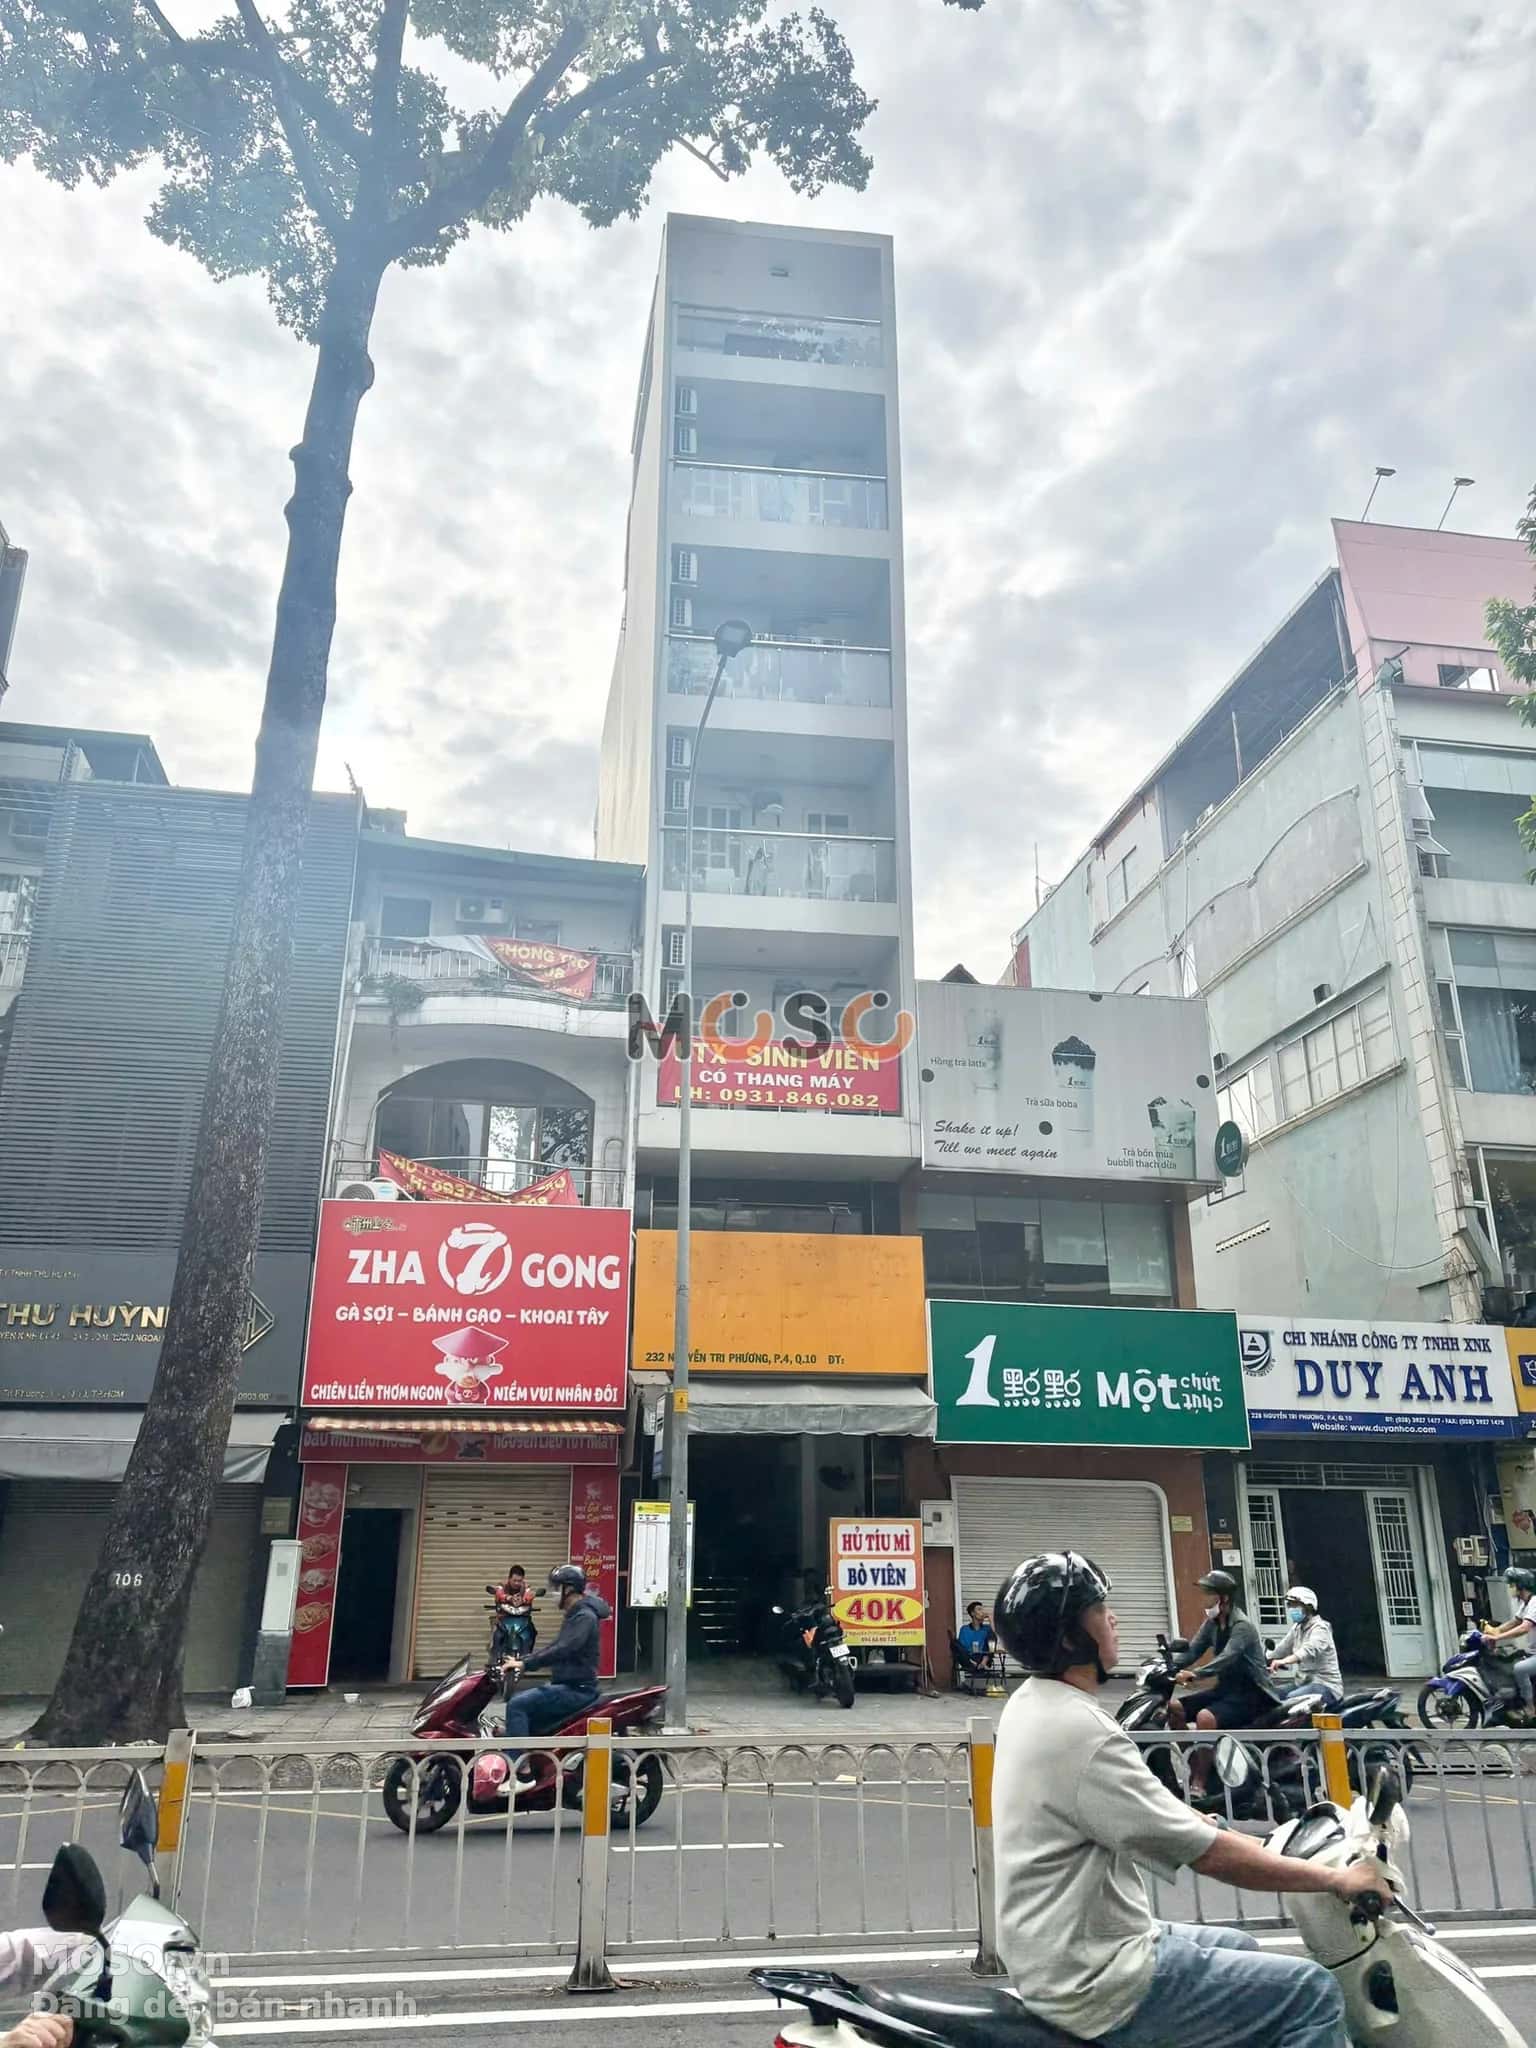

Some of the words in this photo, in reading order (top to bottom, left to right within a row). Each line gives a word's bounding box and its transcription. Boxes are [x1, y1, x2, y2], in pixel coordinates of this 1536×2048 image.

[745, 1045, 808, 1069] SINH
[818, 1045, 881, 1072] VIÊN
[699, 1068, 728, 1084] CÓ
[734, 1071, 804, 1088] THANG
[810, 1073, 855, 1089] MÁY
[719, 1087, 880, 1108] 0931.846.082
[1056, 1098, 1078, 1109] boba
[934, 1119, 976, 1135] Shake
[980, 1124, 992, 1136] it
[995, 1123, 1019, 1139] up!
[934, 1139, 960, 1153] Till
[964, 1144, 982, 1155] we
[986, 1146, 1017, 1157] meet
[1020, 1148, 1058, 1161] again
[347, 1248, 427, 1286] ZHA
[520, 1253, 621, 1290] GONG
[69, 1299, 170, 1329] HUỲN
[335, 1302, 360, 1322] GÀ
[362, 1303, 394, 1325] SỢI
[412, 1303, 463, 1324] BÁNH
[465, 1310, 502, 1326] GẠO
[520, 1308, 573, 1326] KHOAI
[577, 1306, 610, 1326] TÂY
[1283, 1331, 1308, 1346] CHI
[1310, 1328, 1358, 1349] NHÁNH
[1361, 1330, 1398, 1350] CÔNG
[1401, 1335, 1418, 1350] TY
[1422, 1335, 1461, 1352] TNHH
[1463, 1337, 1493, 1353] XNK
[645, 1352, 665, 1363] 232
[709, 1353, 726, 1364] TRI
[728, 1352, 772, 1365] PHƯƠNG,
[773, 1353, 794, 1366] P.4,
[795, 1353, 818, 1366] Q.10
[828, 1354, 845, 1366] ĐT:
[955, 1334, 1001, 1408] 1
[1097, 1368, 1181, 1414] Một
[1180, 1371, 1223, 1392] chút
[1294, 1358, 1384, 1400] DUY
[1400, 1362, 1494, 1403] ANH
[310, 1380, 346, 1401] CHIÊN
[375, 1383, 409, 1401] THƠM
[410, 1385, 444, 1401] NGON
[530, 1386, 553, 1402] VUI
[555, 1383, 593, 1402] NHÂN
[594, 1383, 619, 1403] ĐÔI
[1312, 1422, 1348, 1432] Website:
[1350, 1423, 1437, 1434] www.duyanhco.com
[841, 1526, 863, 1552] HỦ
[865, 1528, 891, 1552] TÍU
[893, 1528, 911, 1552] MÌ
[847, 1562, 868, 1586] BÒ
[870, 1562, 907, 1586] VIÊN
[846, 1597, 906, 1622] 40K
